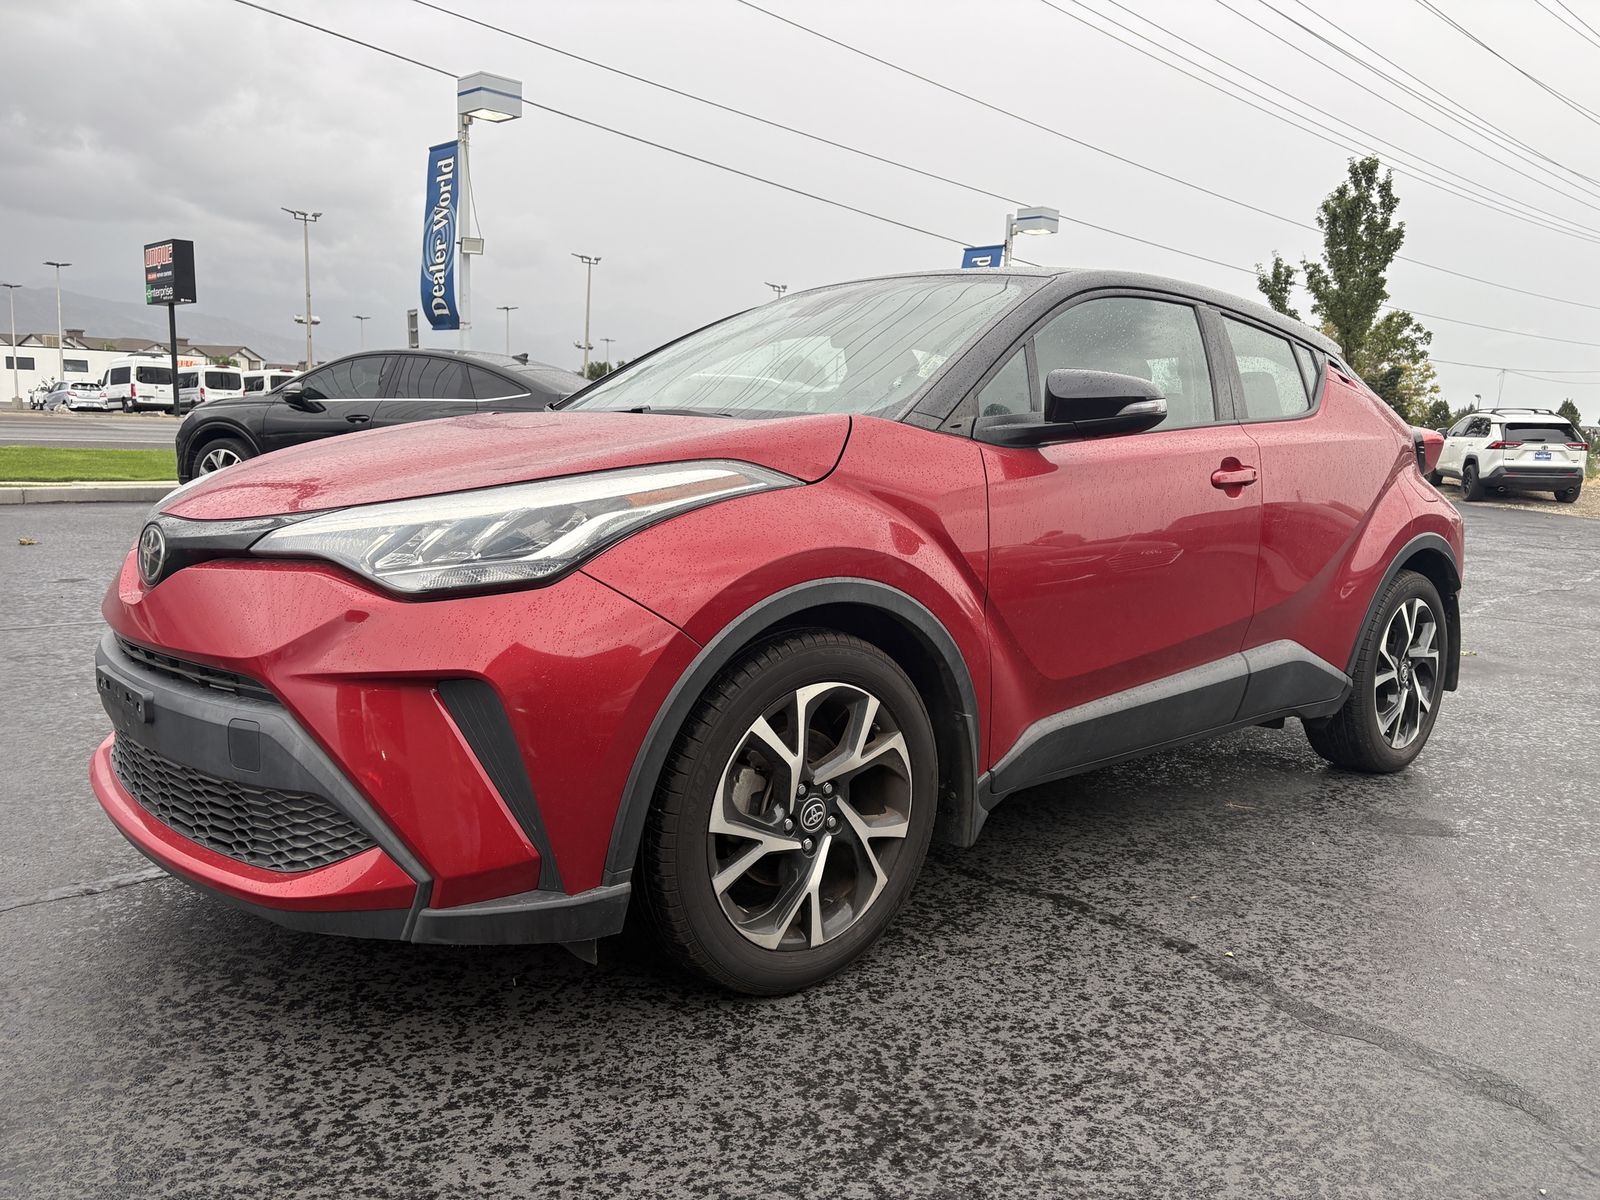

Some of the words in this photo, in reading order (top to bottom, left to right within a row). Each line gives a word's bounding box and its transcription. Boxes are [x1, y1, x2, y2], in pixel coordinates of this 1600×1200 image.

[432, 156, 455, 233] World
[145, 243, 173, 269] UNIQUE
[429, 239, 451, 317] Dealer
[147, 285, 174, 299] enterprise
